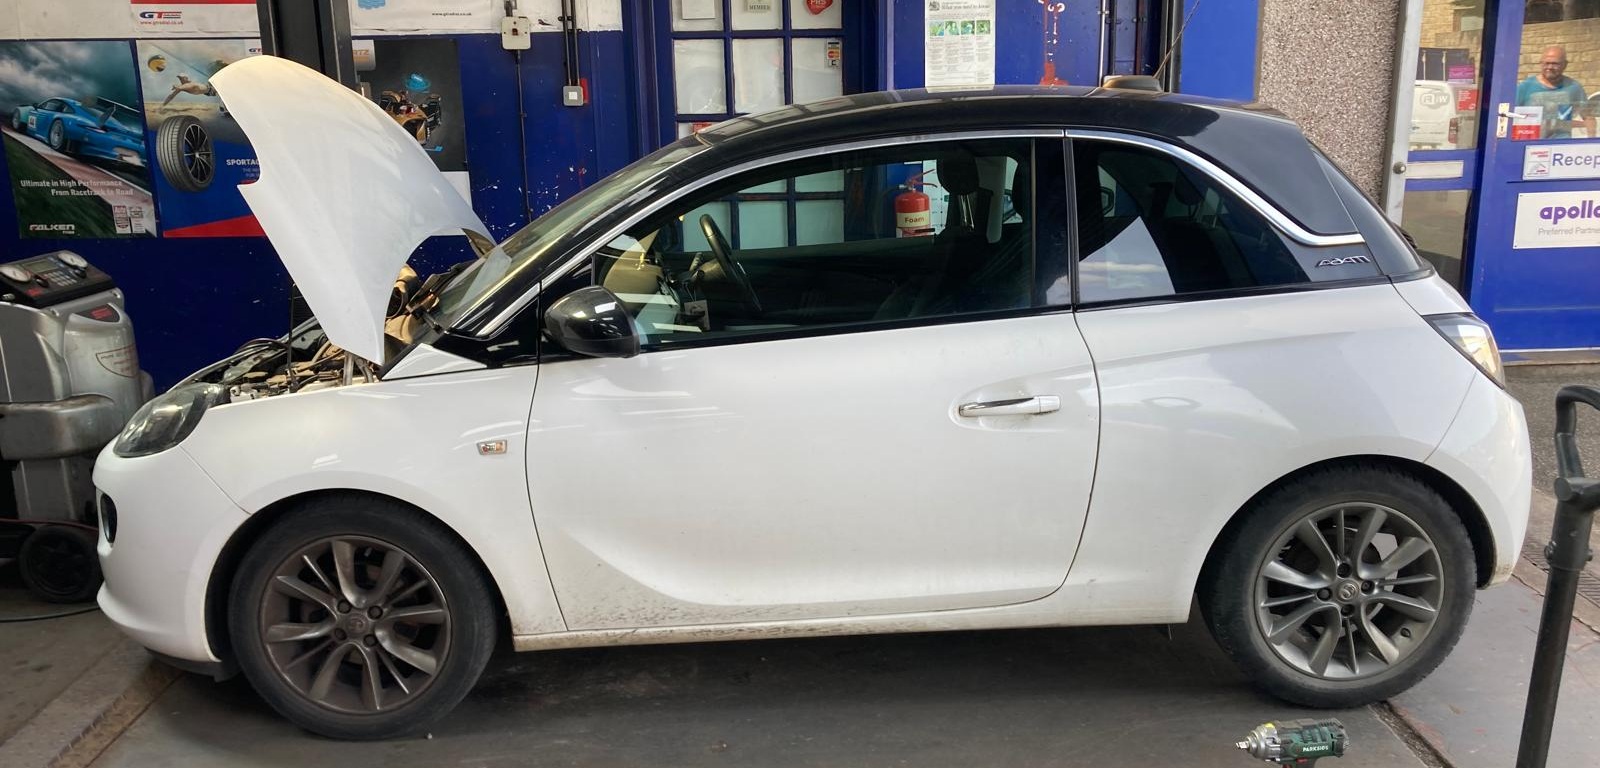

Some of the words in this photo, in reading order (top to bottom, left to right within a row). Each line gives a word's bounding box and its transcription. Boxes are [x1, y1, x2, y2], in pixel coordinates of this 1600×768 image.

[20, 179, 50, 187] Ultimate
[51, 179, 58, 187] in
[59, 179, 76, 188] High
[77, 179, 122, 187] Performance
[51, 188, 70, 196] From
[70, 188, 105, 196] Racetrack
[105, 188, 114, 196] to
[115, 188, 134, 196] Road
[1538, 227, 1574, 235] Preferred
